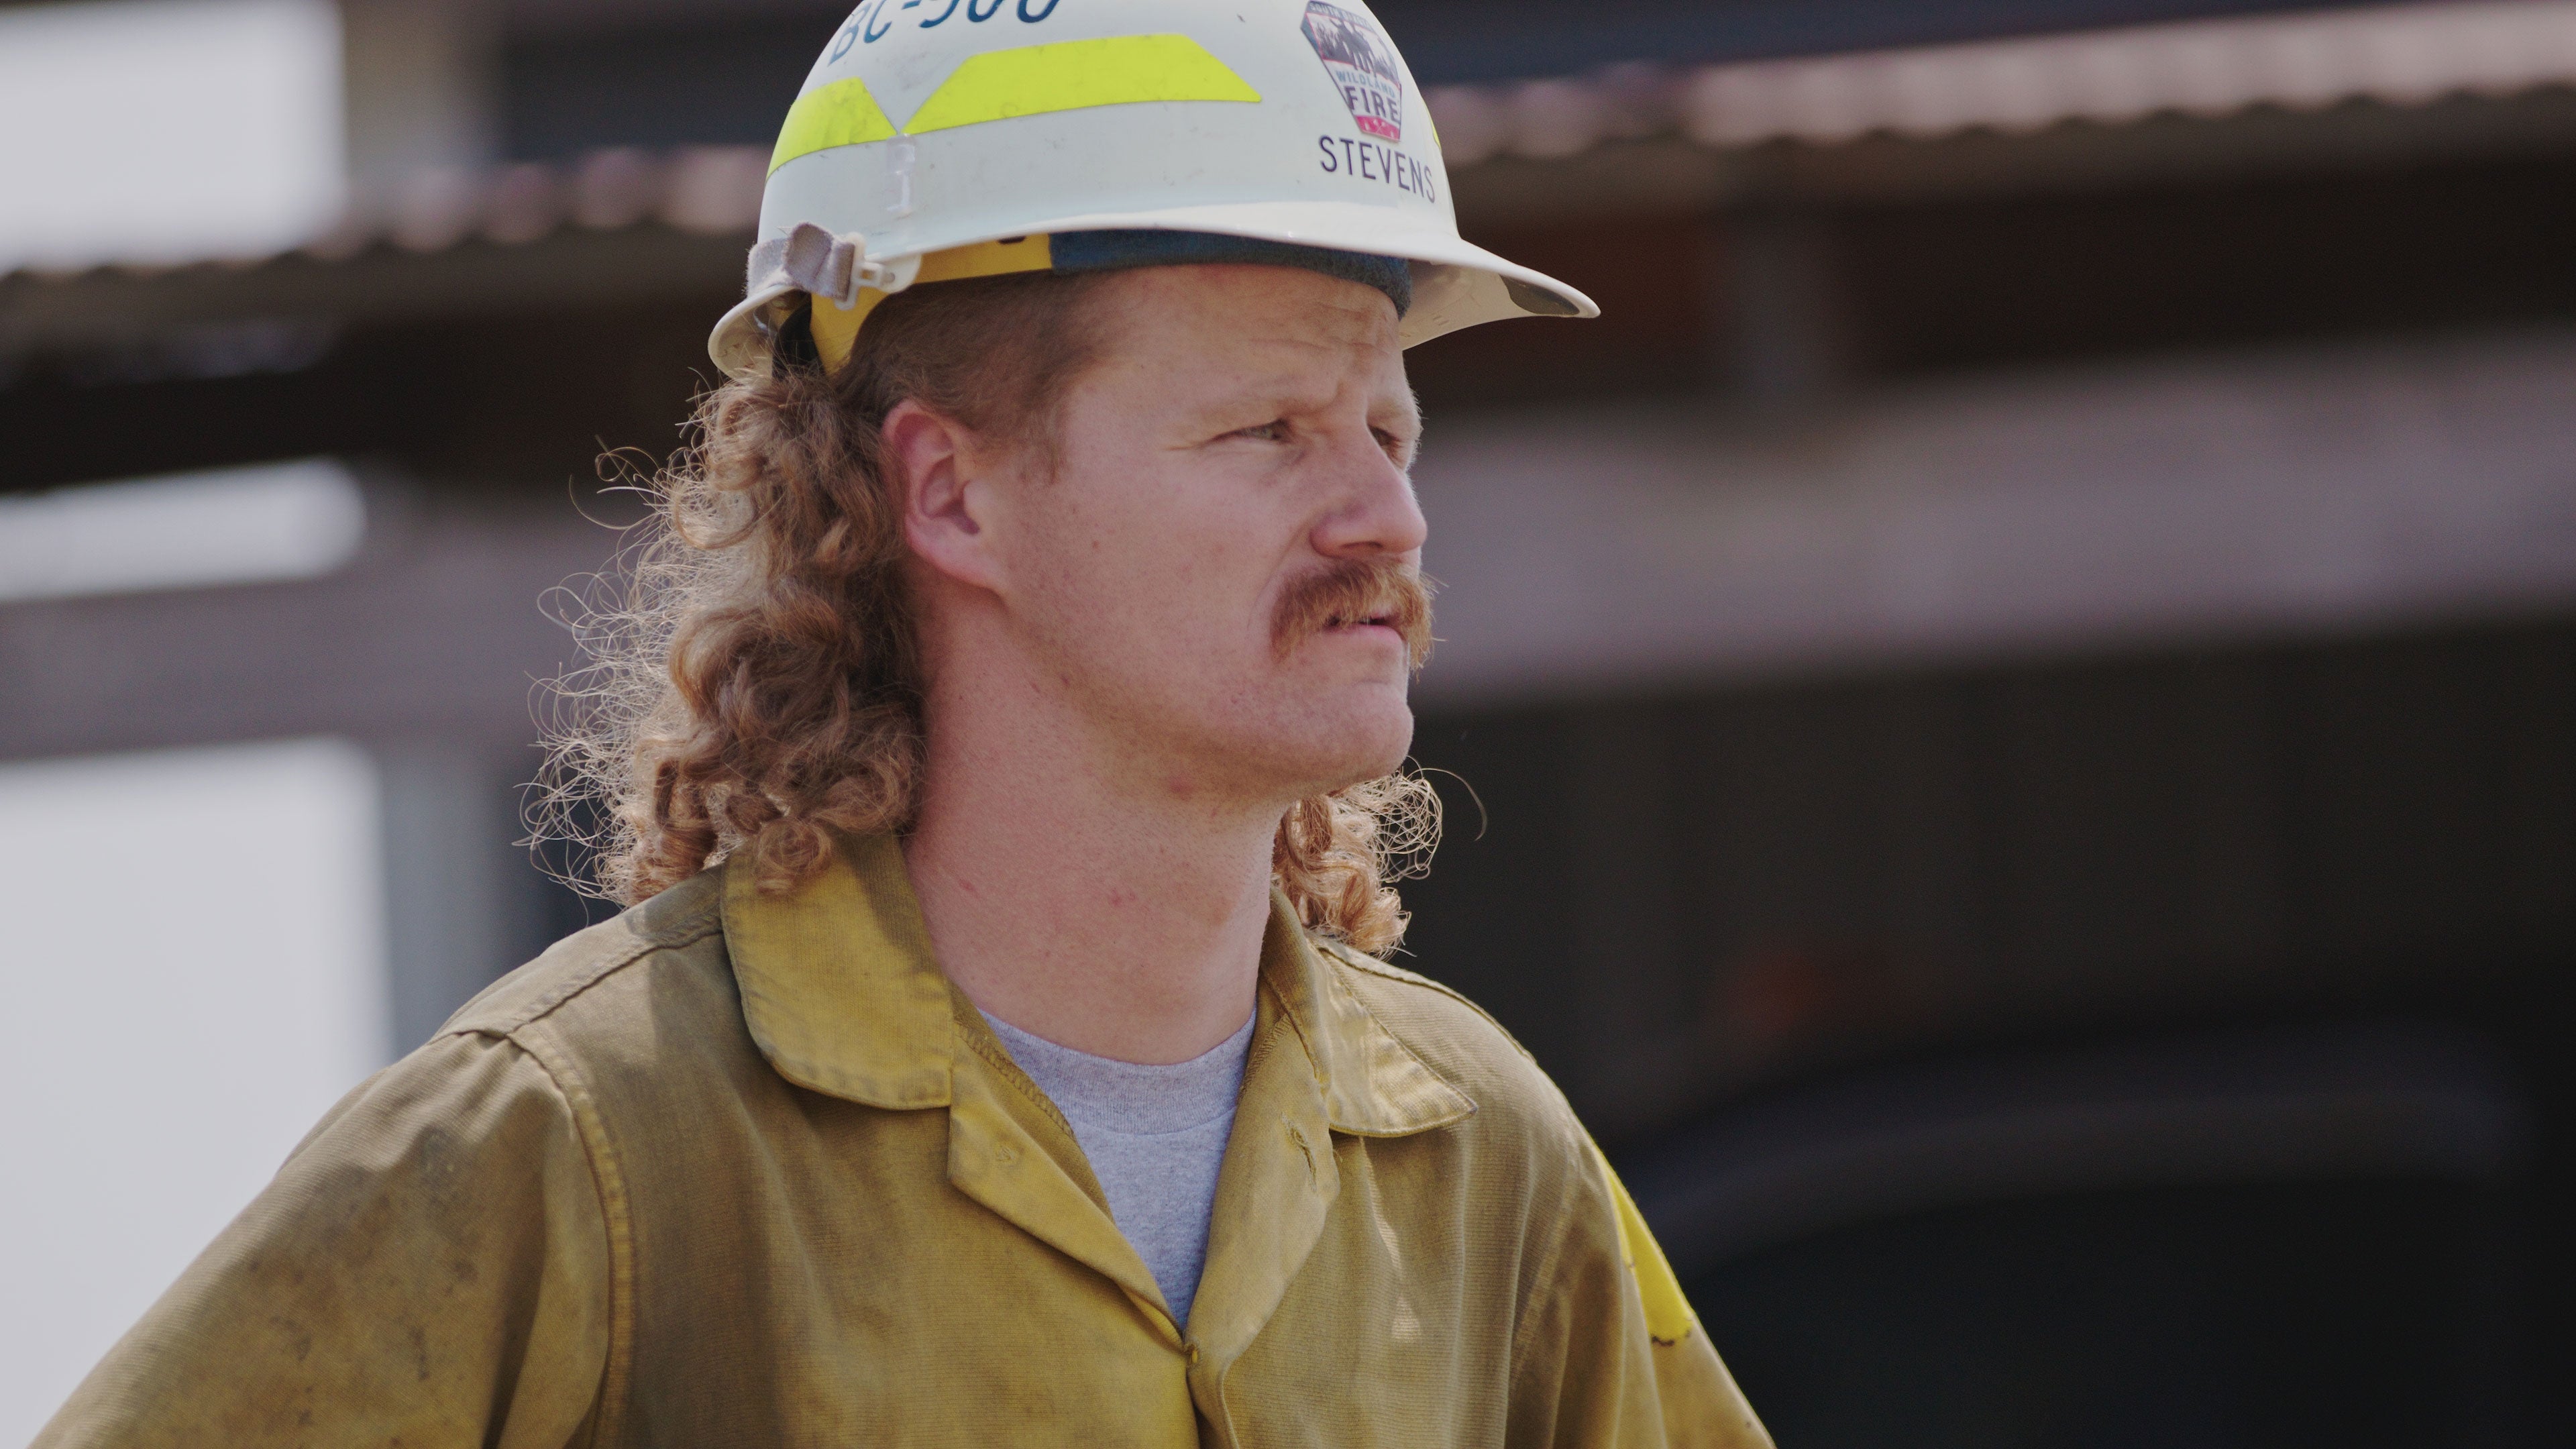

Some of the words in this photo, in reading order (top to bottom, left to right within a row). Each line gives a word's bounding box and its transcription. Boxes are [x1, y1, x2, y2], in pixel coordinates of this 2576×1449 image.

[1336, 70, 1395, 98] WILDLAND
[1344, 85, 1401, 124] FIRE
[1318, 135, 1435, 203] STEVENS
